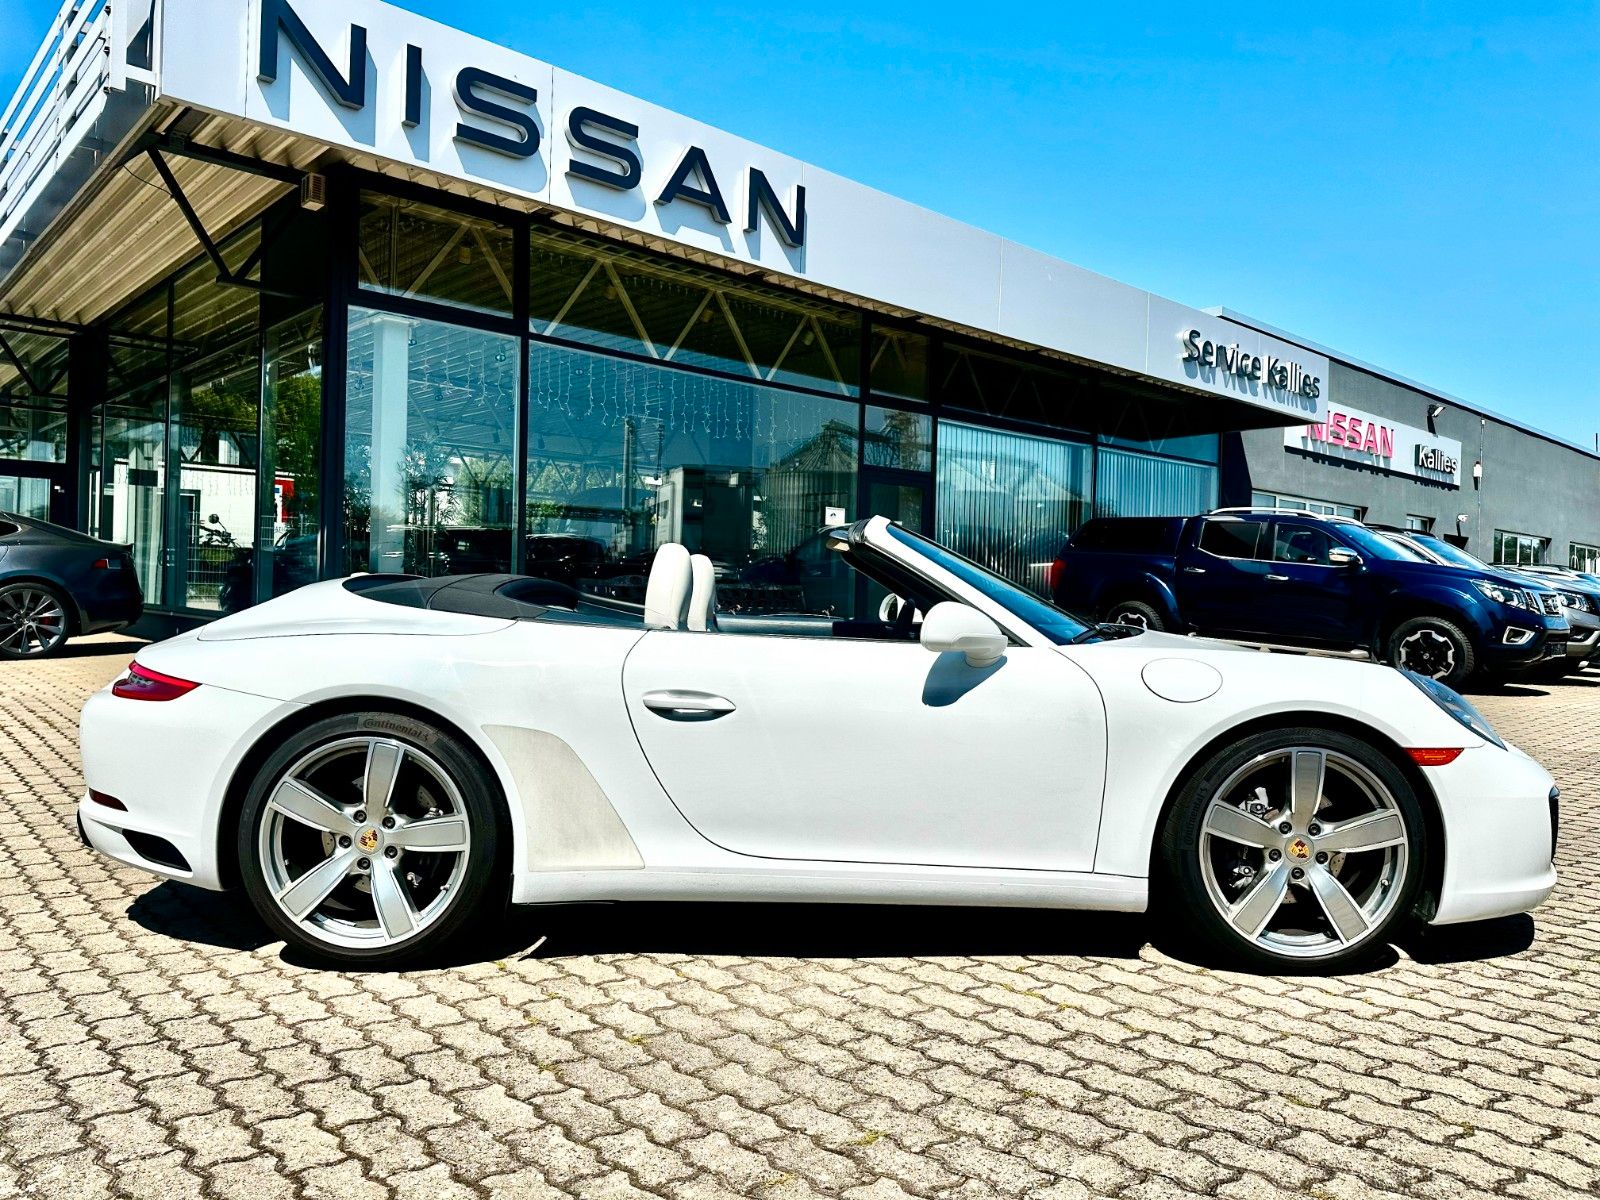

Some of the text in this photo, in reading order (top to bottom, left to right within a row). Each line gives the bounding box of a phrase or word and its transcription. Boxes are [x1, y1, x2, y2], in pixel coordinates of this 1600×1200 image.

[257, 0, 806, 248] NISSAN
[1182, 329, 1321, 399] Service Kallies
[1415, 444, 1458, 474] Kallies
[363, 718, 423, 738] Continental
